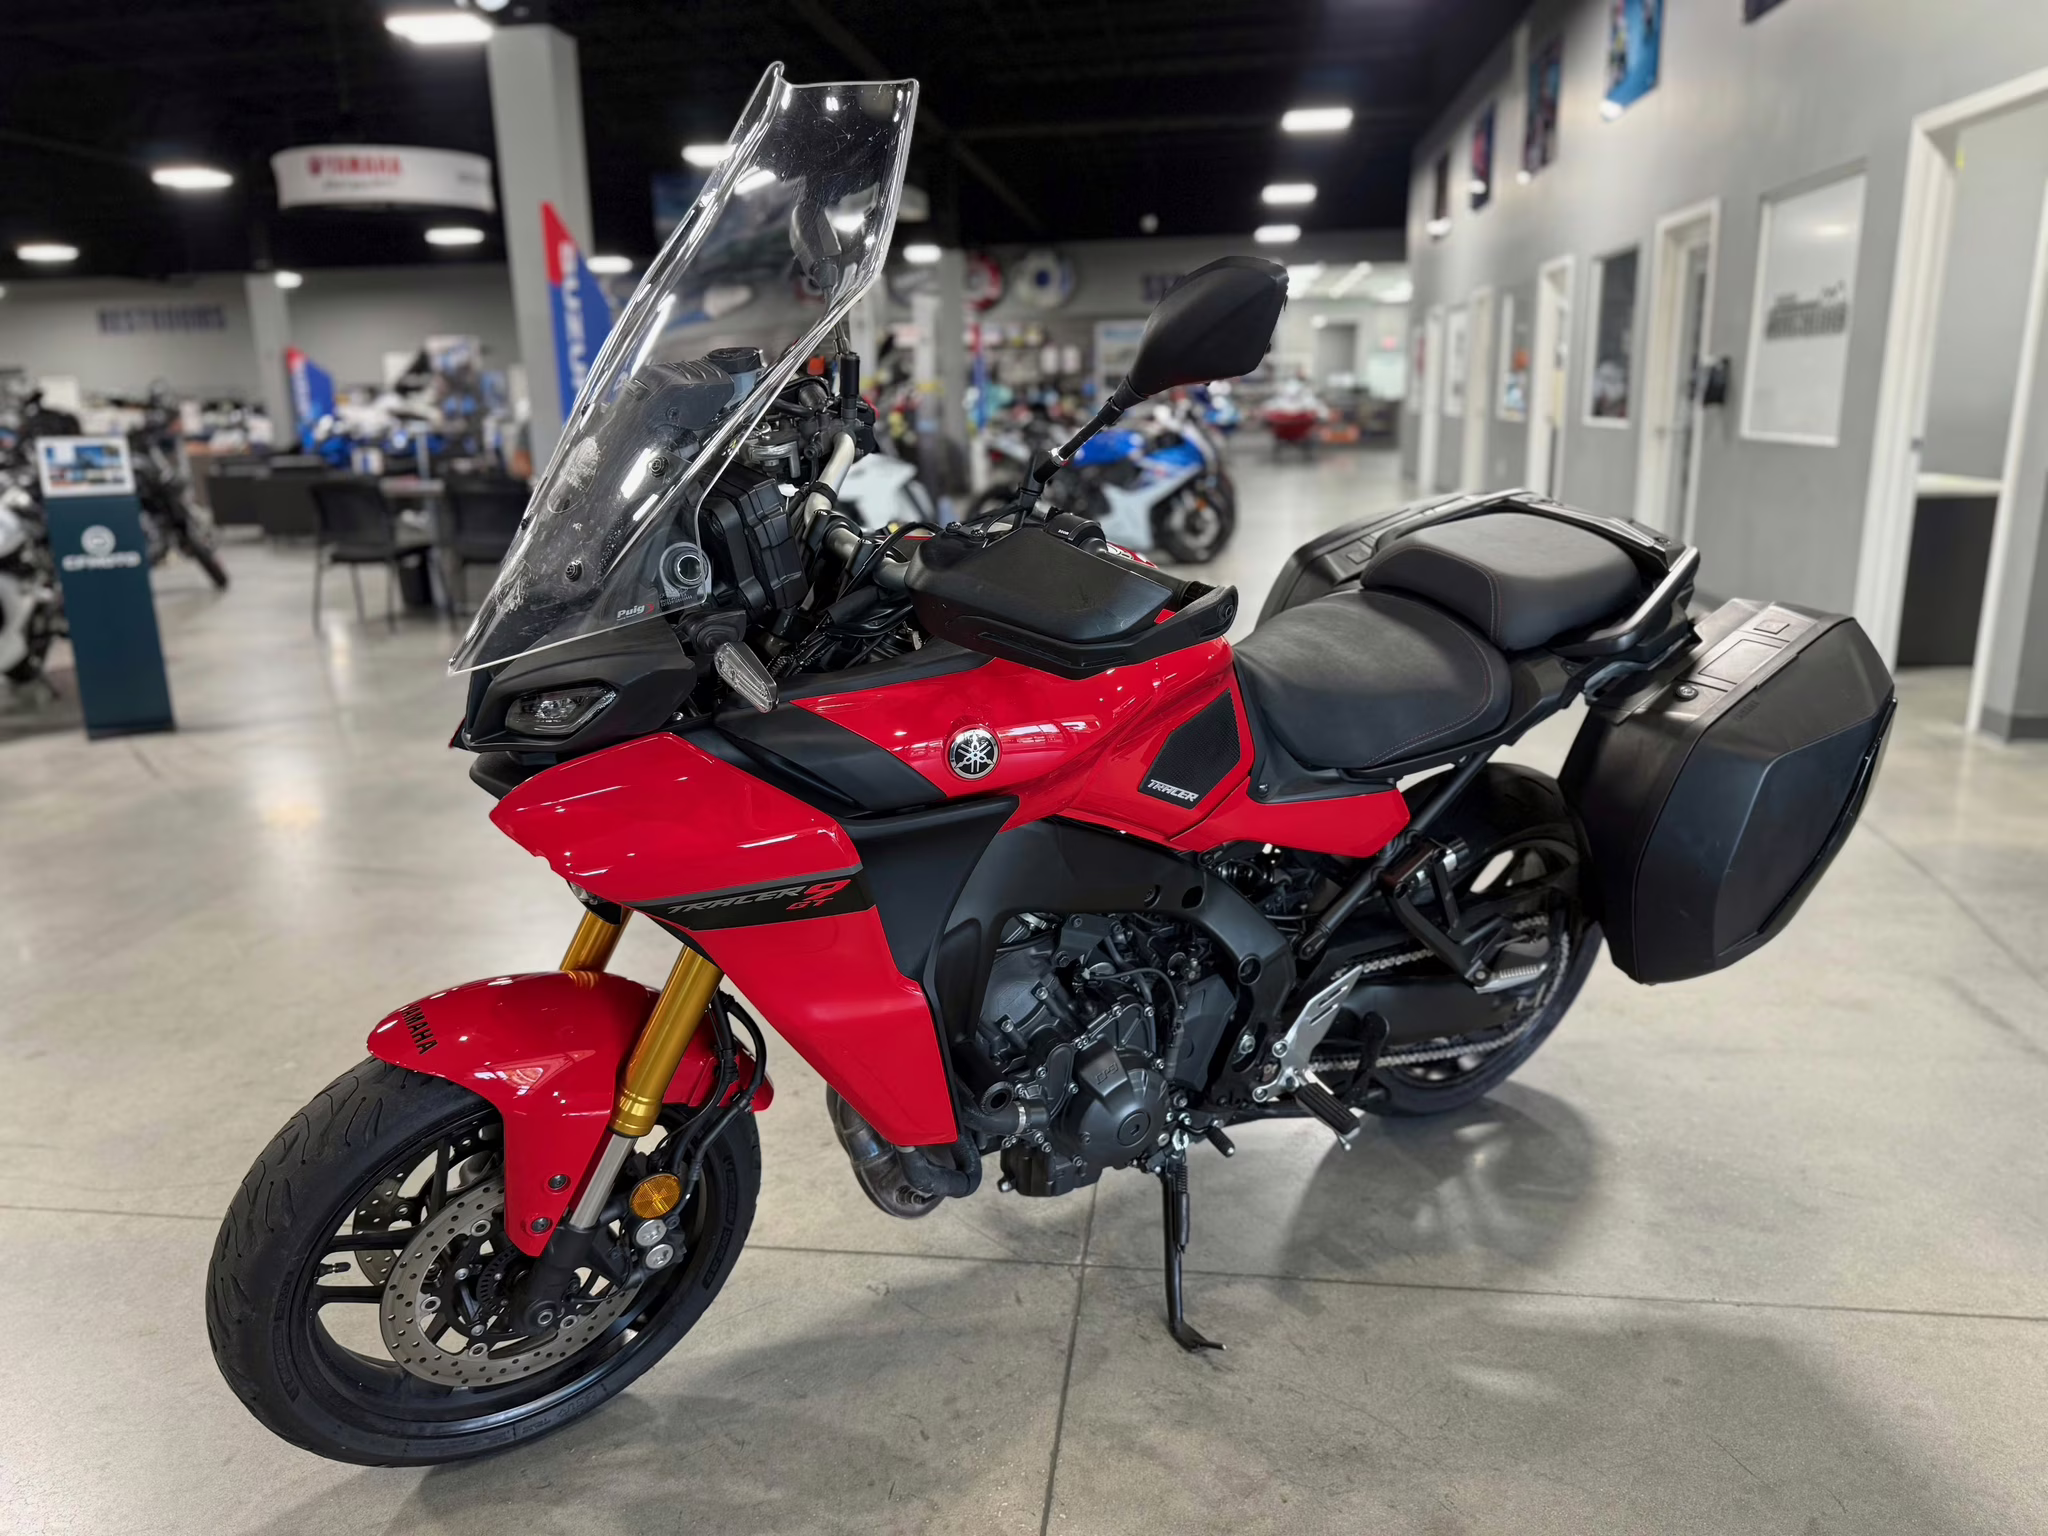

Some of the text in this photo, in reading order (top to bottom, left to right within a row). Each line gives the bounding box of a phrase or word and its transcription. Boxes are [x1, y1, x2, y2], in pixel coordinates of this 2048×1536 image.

[617, 604, 645, 618] Puig
[1147, 779, 1199, 802] TRACER
[668, 879, 851, 914] TRACER 9
[786, 897, 834, 910] GT
[402, 1003, 438, 1055] YAMAHA
